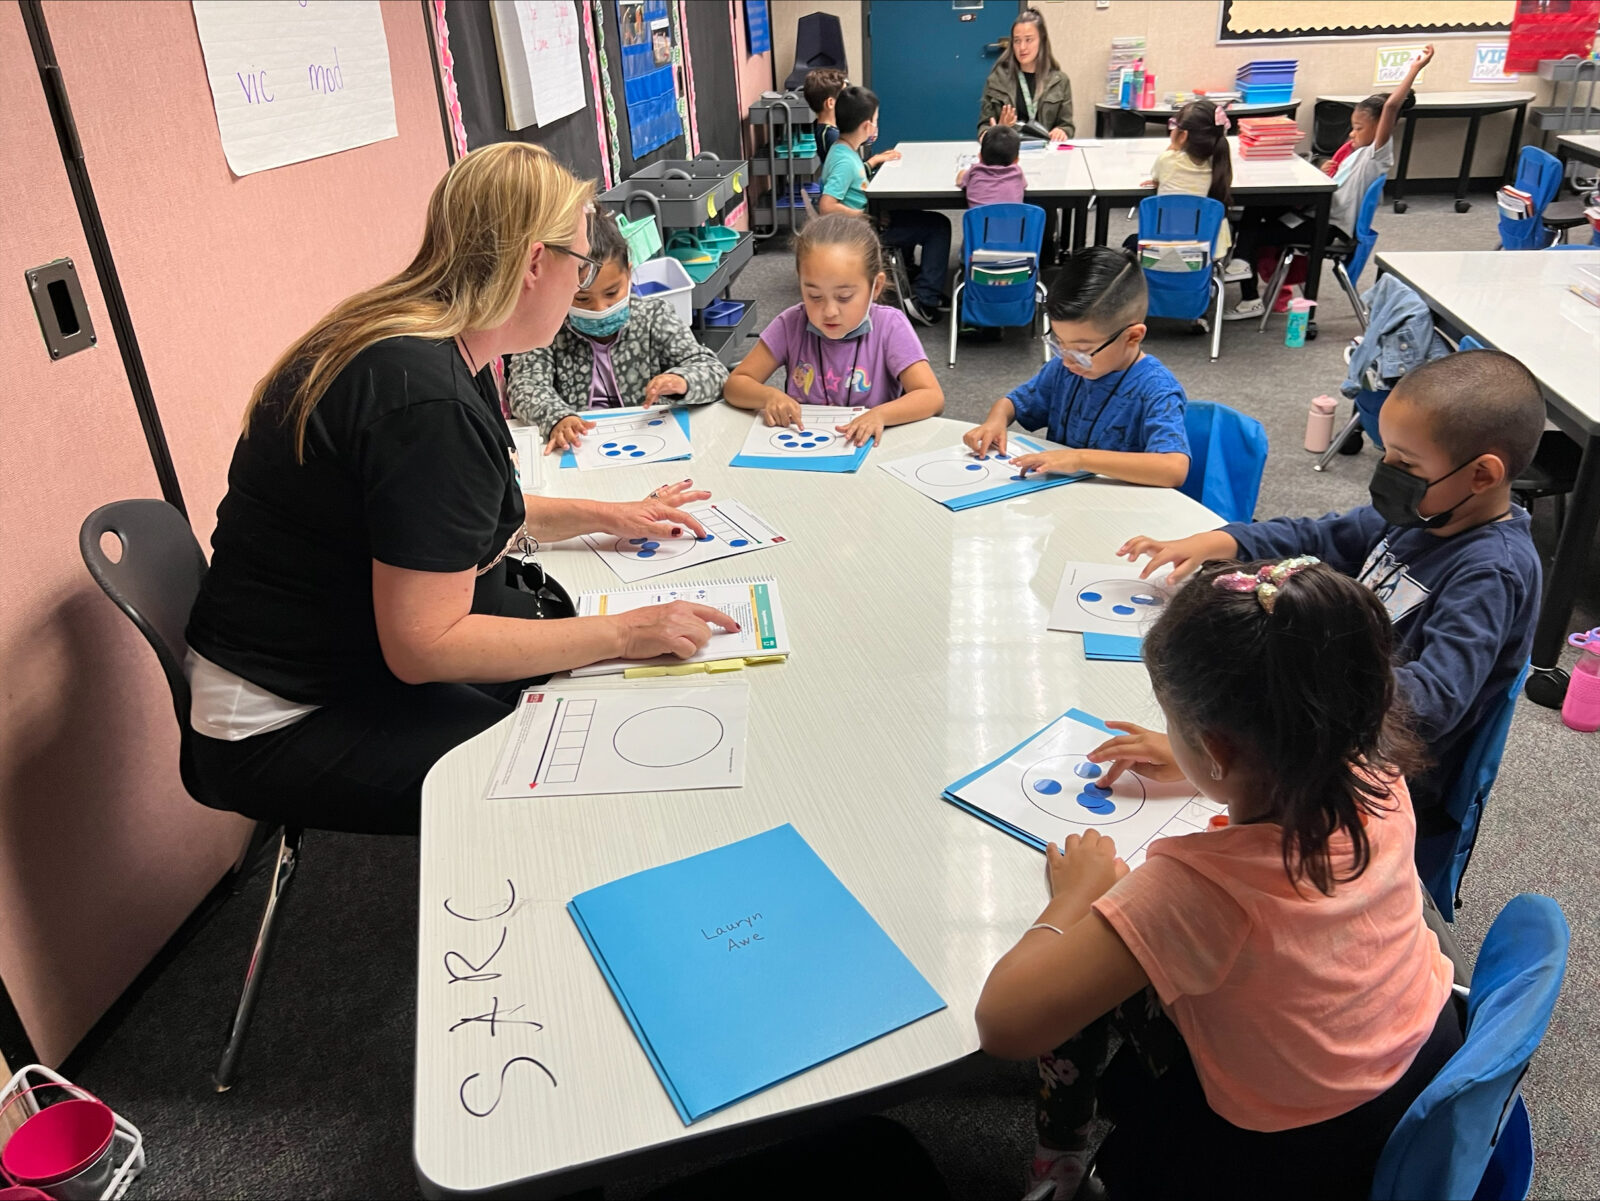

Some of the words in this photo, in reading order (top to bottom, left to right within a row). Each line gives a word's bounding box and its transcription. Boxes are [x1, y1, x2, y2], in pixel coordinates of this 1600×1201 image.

[1380, 51, 1411, 67] VIP
[1478, 49, 1507, 64] VIP
[236, 64, 275, 105] vic
[308, 46, 344, 95] mod
[700, 912, 763, 940] Lauryn
[728, 933, 766, 952] Awe
